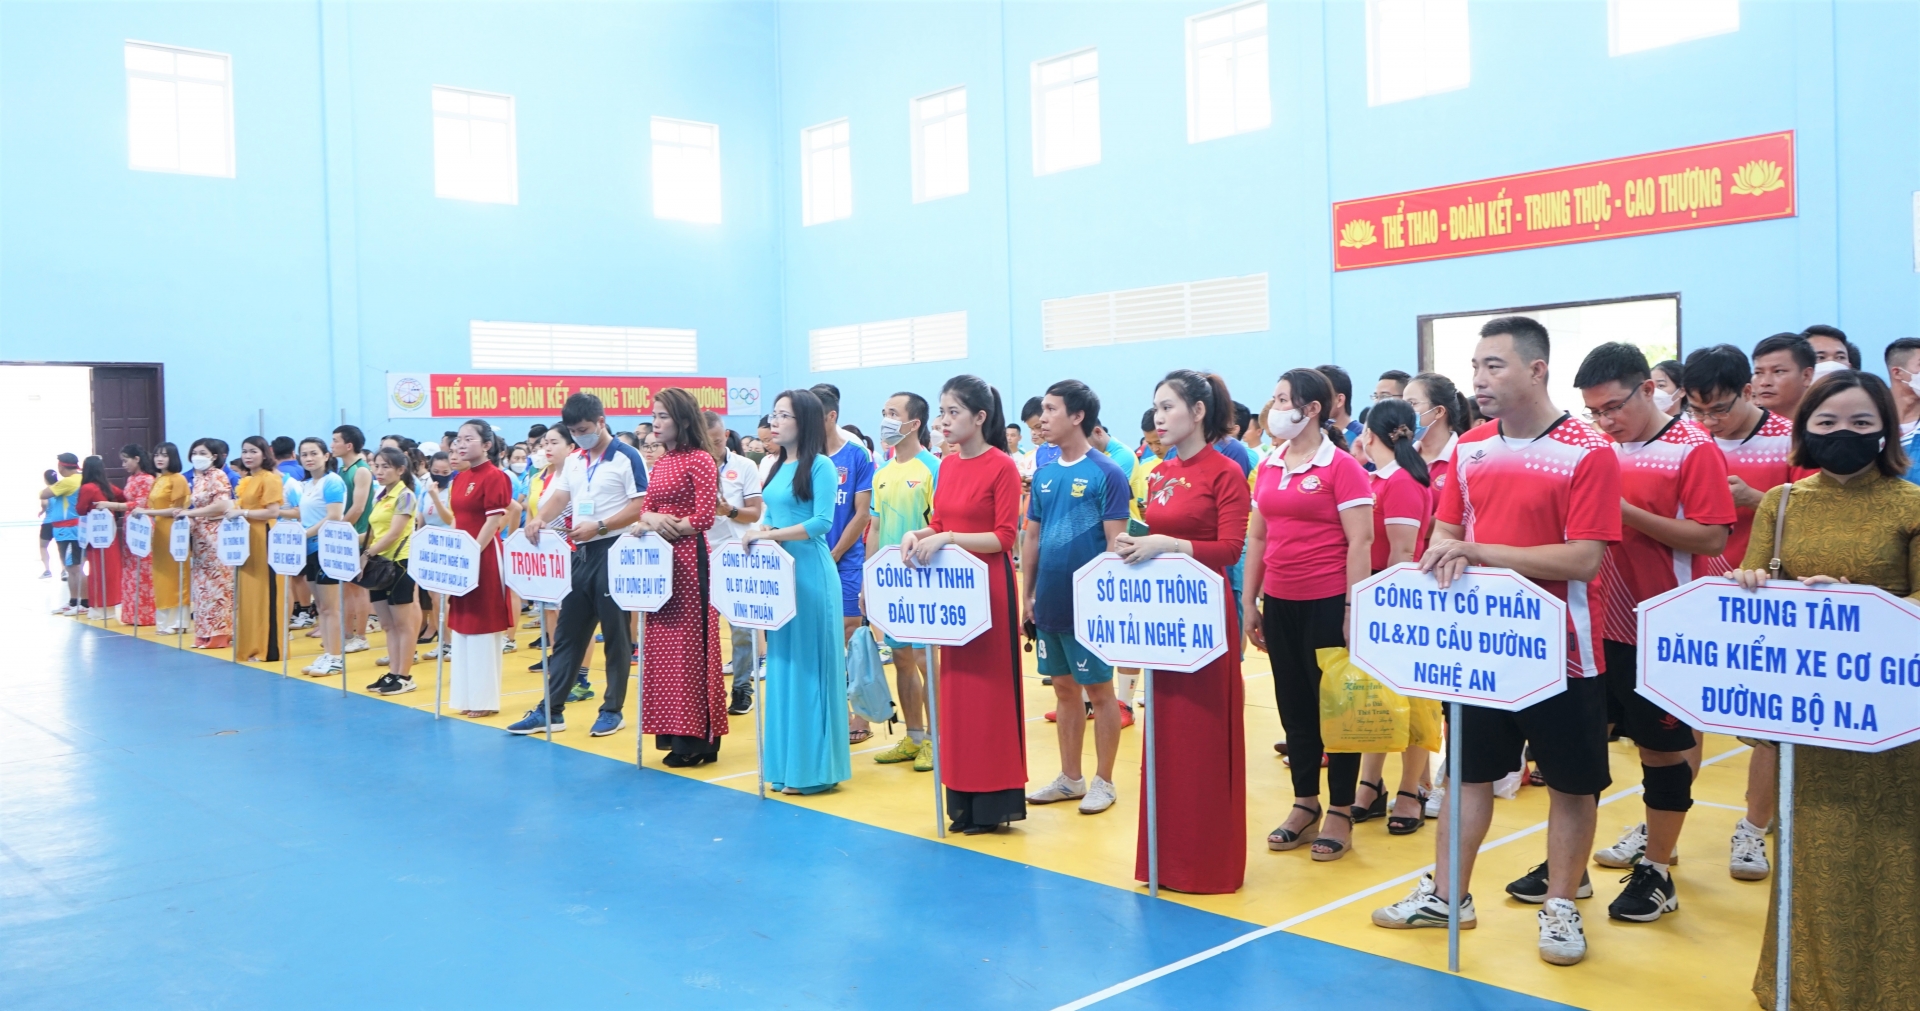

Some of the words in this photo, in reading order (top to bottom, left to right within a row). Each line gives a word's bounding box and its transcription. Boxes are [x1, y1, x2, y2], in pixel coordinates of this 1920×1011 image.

[1382, 200, 1405, 249] THỂ
[1406, 209, 1439, 246] THAO
[1449, 196, 1486, 241] ĐOÀN
[1488, 187, 1513, 236] KẾT
[1524, 189, 1571, 231] TRUNG
[1573, 181, 1612, 231] THỰC
[1625, 177, 1656, 218] CAO
[1658, 166, 1722, 219] THƯỢNG
[436, 377, 462, 409] THỂ
[464, 386, 497, 409] THAO
[509, 382, 544, 409] ĐOÀN
[547, 380, 569, 409] KẾT
[620, 385, 650, 413] THỰC
[511, 551, 547, 581] TRỌNG
[549, 549, 565, 579] TÀI
[620, 546, 635, 565] CÔNG
[636, 548, 643, 565] TY
[645, 548, 660, 565] TNHH
[722, 550, 740, 567] CÔNG
[741, 553, 749, 568] TY
[751, 549, 760, 569] CỔ
[762, 551, 781, 570] PHẦN
[614, 574, 625, 593] XÂY
[626, 576, 641, 598] DỰNG
[643, 577, 652, 598] ĐẠI
[654, 574, 666, 598] VIỆT
[726, 577, 734, 593] QL
[736, 578, 743, 593] ĐT
[745, 576, 758, 594] XÂY
[760, 580, 779, 598] DỰNG
[876, 563, 913, 588] CÔNG
[916, 568, 932, 588] TY
[936, 568, 975, 589] TNHH
[1097, 571, 1115, 602] SỞ
[1120, 578, 1152, 603] GIAO
[1156, 574, 1208, 605] THÔNG
[733, 600, 748, 618] VĨNH
[749, 603, 774, 623] THUẬN
[888, 596, 915, 624] ĐẦU
[918, 602, 936, 625] TƯ
[940, 604, 967, 626] 369
[1374, 583, 1422, 610] CÔNG
[1428, 590, 1448, 612] TY
[1454, 585, 1480, 615] CỔ
[1486, 589, 1541, 620] PHẦN
[1718, 596, 1797, 628] TRUNG
[1805, 597, 1860, 632] TÂM
[1087, 615, 1115, 648] VẬN
[1119, 613, 1140, 645] TẢI
[1144, 618, 1187, 653] NGHỆ
[1192, 623, 1214, 649] AN
[1369, 621, 1430, 647] QL&XD
[1436, 622, 1472, 651] CẦU
[1479, 629, 1547, 660] ĐƯỜNG
[1657, 632, 1718, 667] ĐĂNG
[1726, 634, 1787, 674] KIỂM
[1795, 648, 1827, 678] XE
[1836, 652, 1871, 682] CƠ
[1414, 661, 1463, 692] NGHỆ
[1469, 669, 1496, 692] AN
[1702, 683, 1783, 721] ĐƯỜNG
[1791, 693, 1825, 731] BỘ
[1834, 700, 1878, 732] N.A
